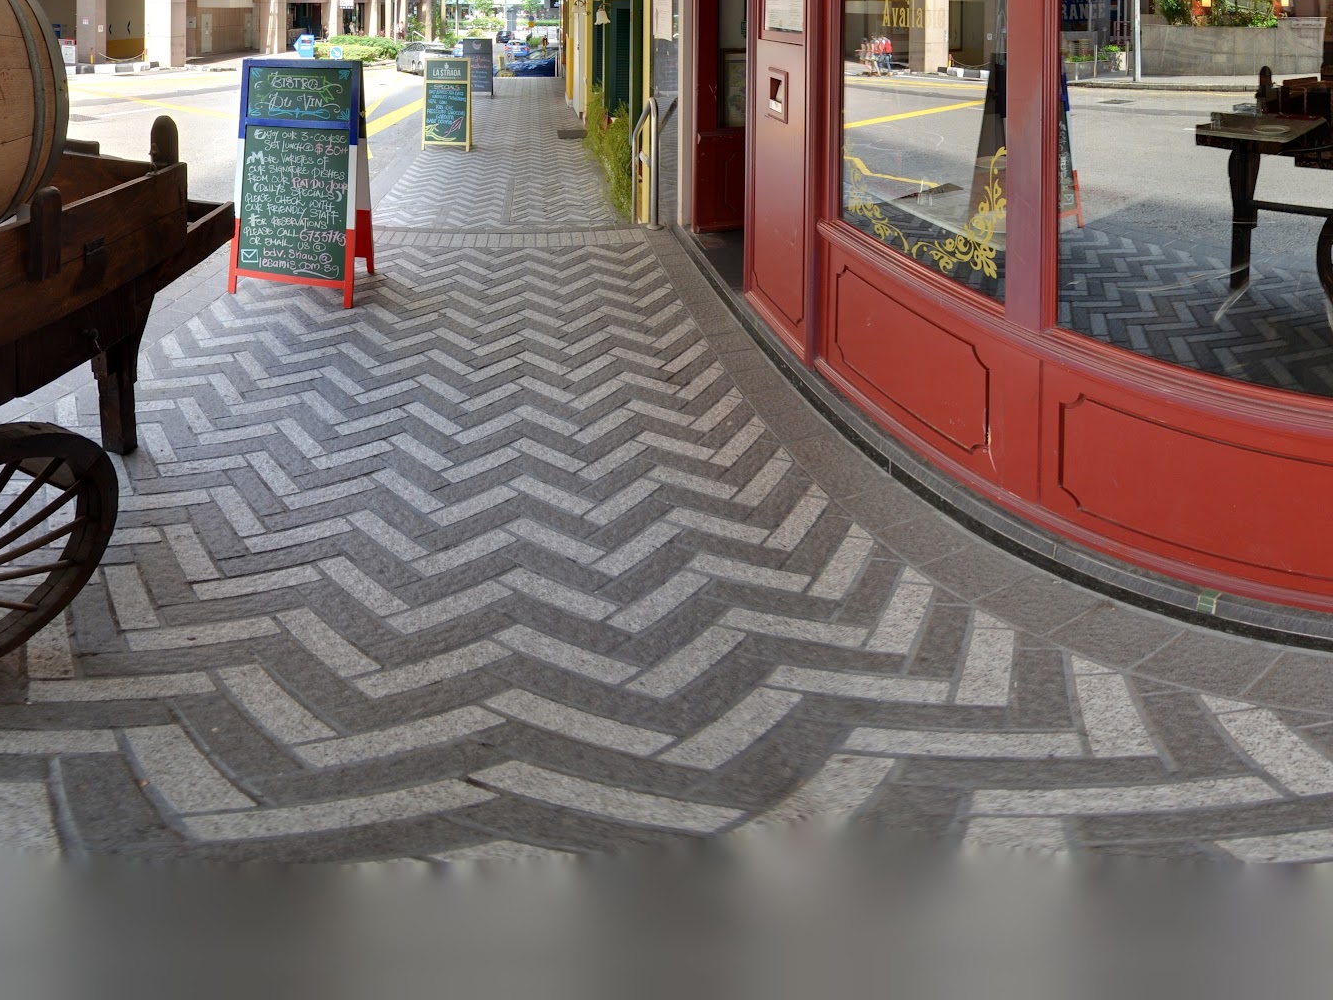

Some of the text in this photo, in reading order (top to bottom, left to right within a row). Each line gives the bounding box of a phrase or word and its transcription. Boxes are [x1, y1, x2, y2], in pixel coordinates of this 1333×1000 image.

[432, 68, 462, 77] LA STRADA
[271, 71, 319, 90] BISTRO
[269, 92, 323, 110] DU VIN
[281, 130, 298, 141] OUR
[264, 140, 281, 151] SET
[246, 150, 279, 165] MORE
[317, 155, 329, 170] OF
[248, 164, 345, 180] OUR SIGNATURE DISHES
[247, 172, 269, 184] FROM
[271, 175, 290, 185] OUR
[292, 177, 310, 189] PLAT
[312, 178, 324, 189] DU
[244, 192, 272, 204] PLEASE
[274, 194, 305, 206] CHECK
[244, 203, 264, 213] OUR
[267, 203, 308, 218] FRIENDLY
[247, 213, 328, 230] FOR RESERVATIONS
[243, 226, 273, 237] PLEASE
[276, 228, 299, 237] CALL
[249, 236, 262, 246] OR
[297, 242, 311, 250] US
[313, 242, 327, 252] @
[318, 253, 333, 264] @
